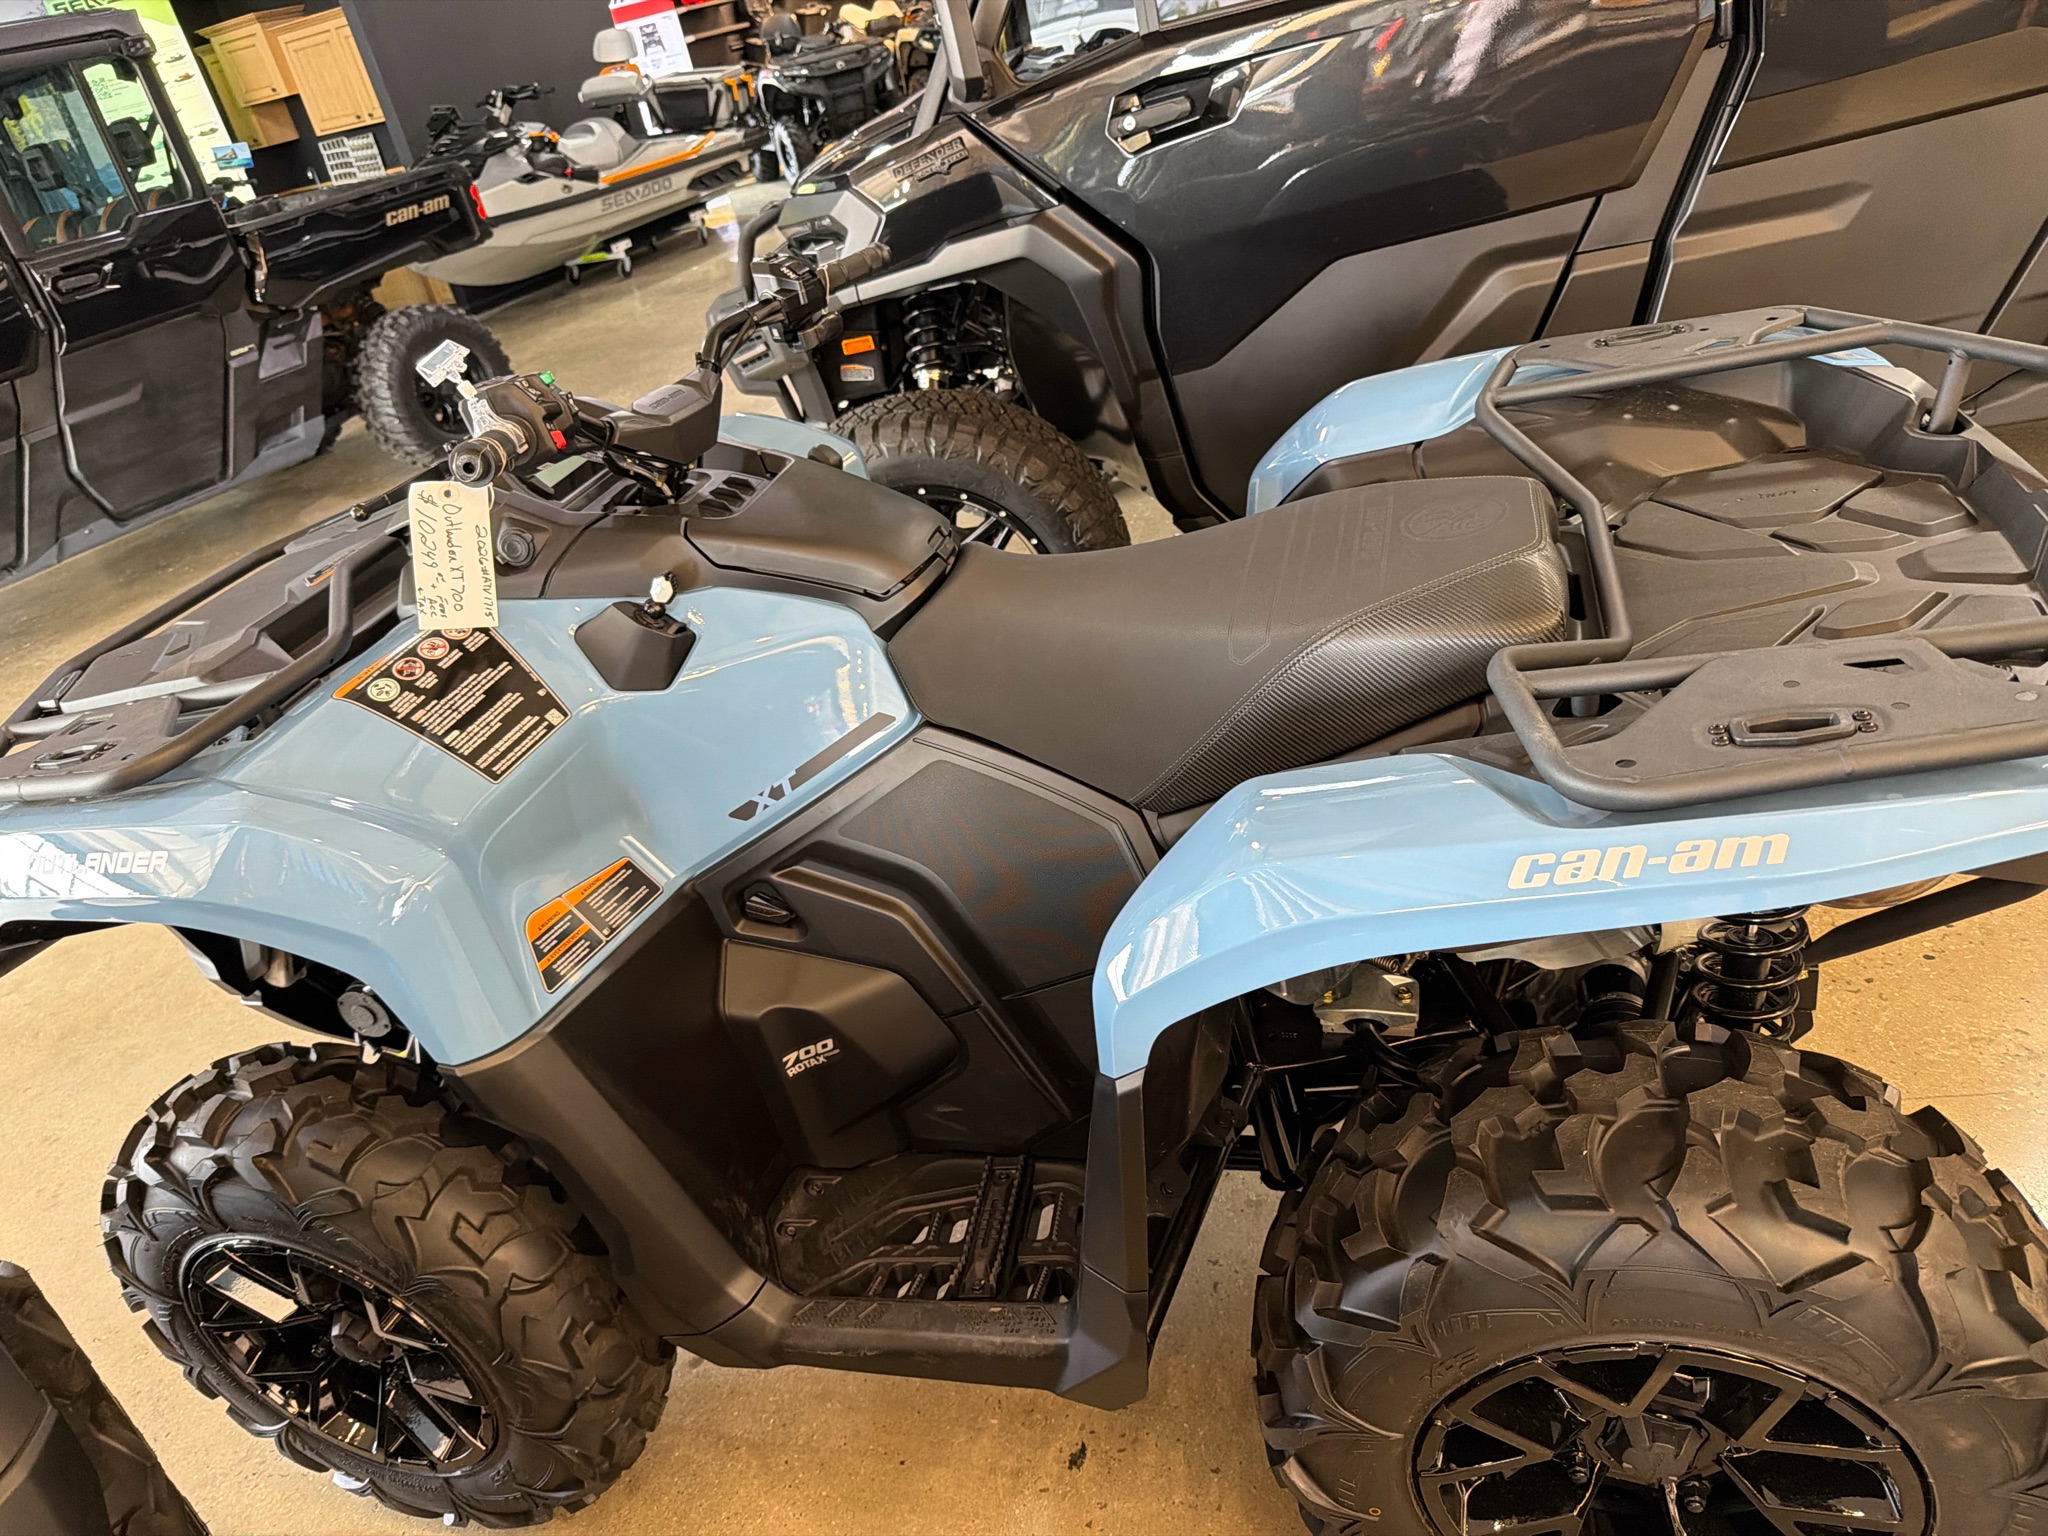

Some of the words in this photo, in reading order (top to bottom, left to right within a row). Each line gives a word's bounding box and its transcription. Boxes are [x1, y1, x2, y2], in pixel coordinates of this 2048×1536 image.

[894, 138, 963, 178] DEFENDER
[386, 195, 450, 227] can-am
[450, 565, 465, 582] XT
[451, 585, 466, 612] 700
[750, 770, 797, 816] XT
[1508, 834, 1790, 890] can-am
[782, 1038, 834, 1070] 700
[786, 1054, 828, 1078] ROTAX
